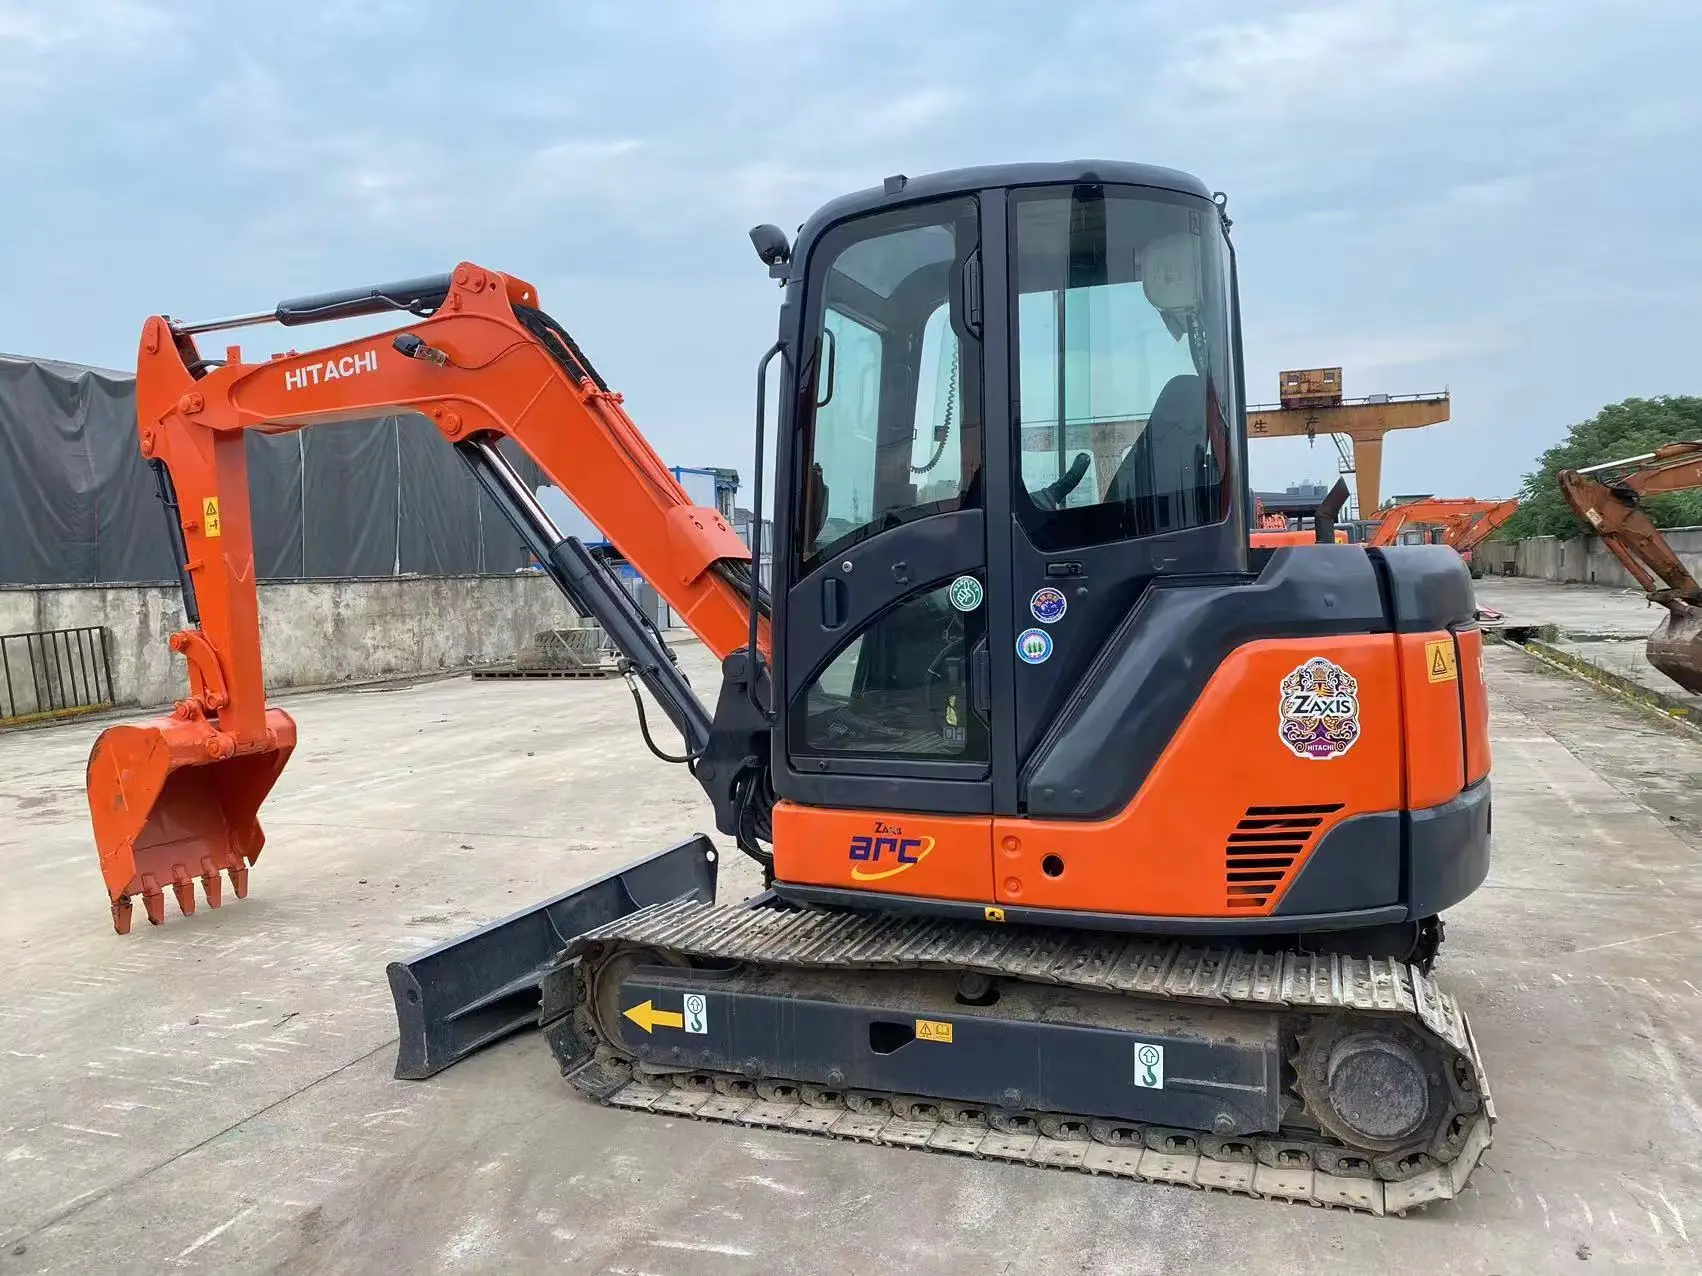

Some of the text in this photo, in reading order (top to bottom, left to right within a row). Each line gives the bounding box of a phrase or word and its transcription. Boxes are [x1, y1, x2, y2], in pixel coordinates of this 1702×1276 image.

[284, 349, 378, 391] HITACHI
[1292, 695, 1352, 716] ZAXIS
[1307, 744, 1335, 752] HITACHI
[874, 821, 903, 835] ZAS
[849, 836, 922, 864] arc
